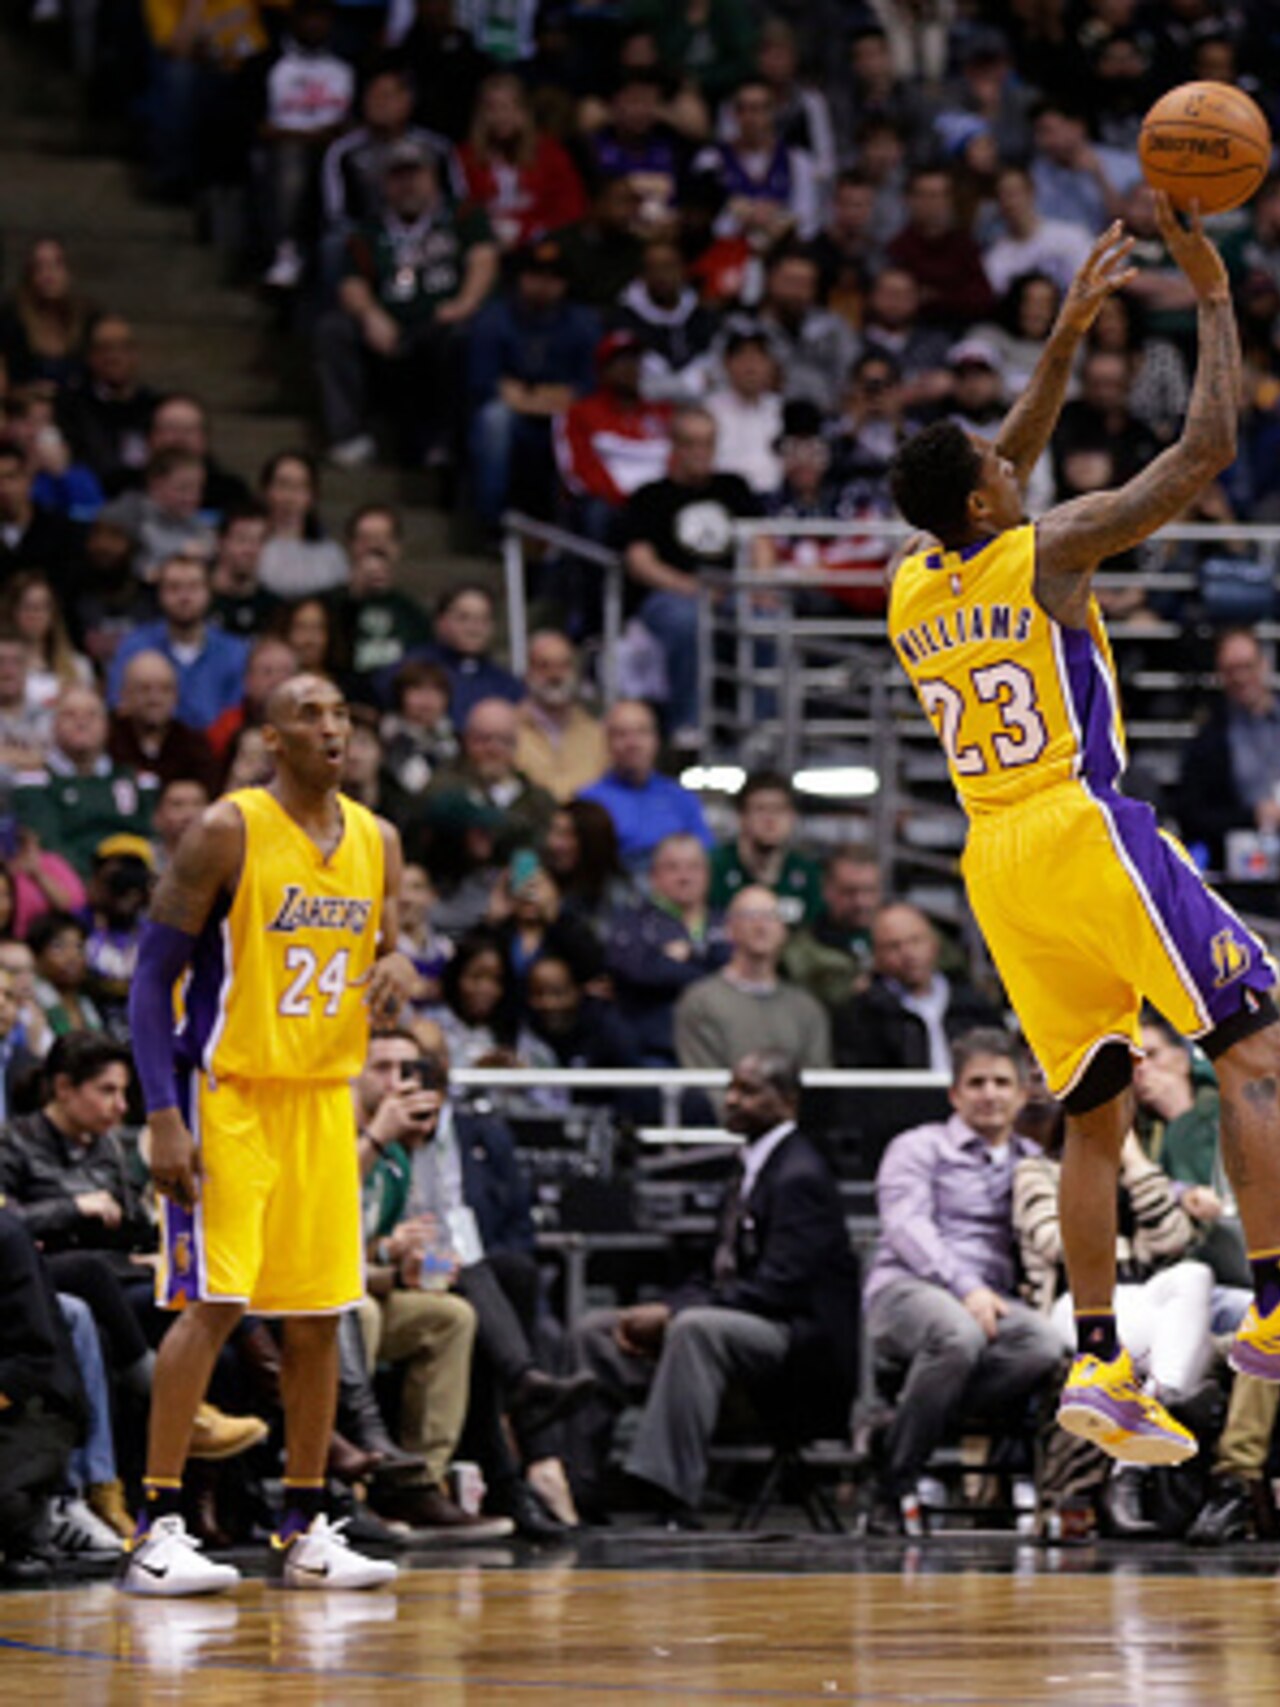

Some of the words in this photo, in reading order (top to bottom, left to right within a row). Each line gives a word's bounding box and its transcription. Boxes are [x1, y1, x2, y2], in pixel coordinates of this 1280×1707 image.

[897, 604, 1033, 667] WILLIAMS
[918, 659, 1048, 776] 23
[265, 885, 372, 934] LAKERS
[277, 945, 350, 1017] 24
